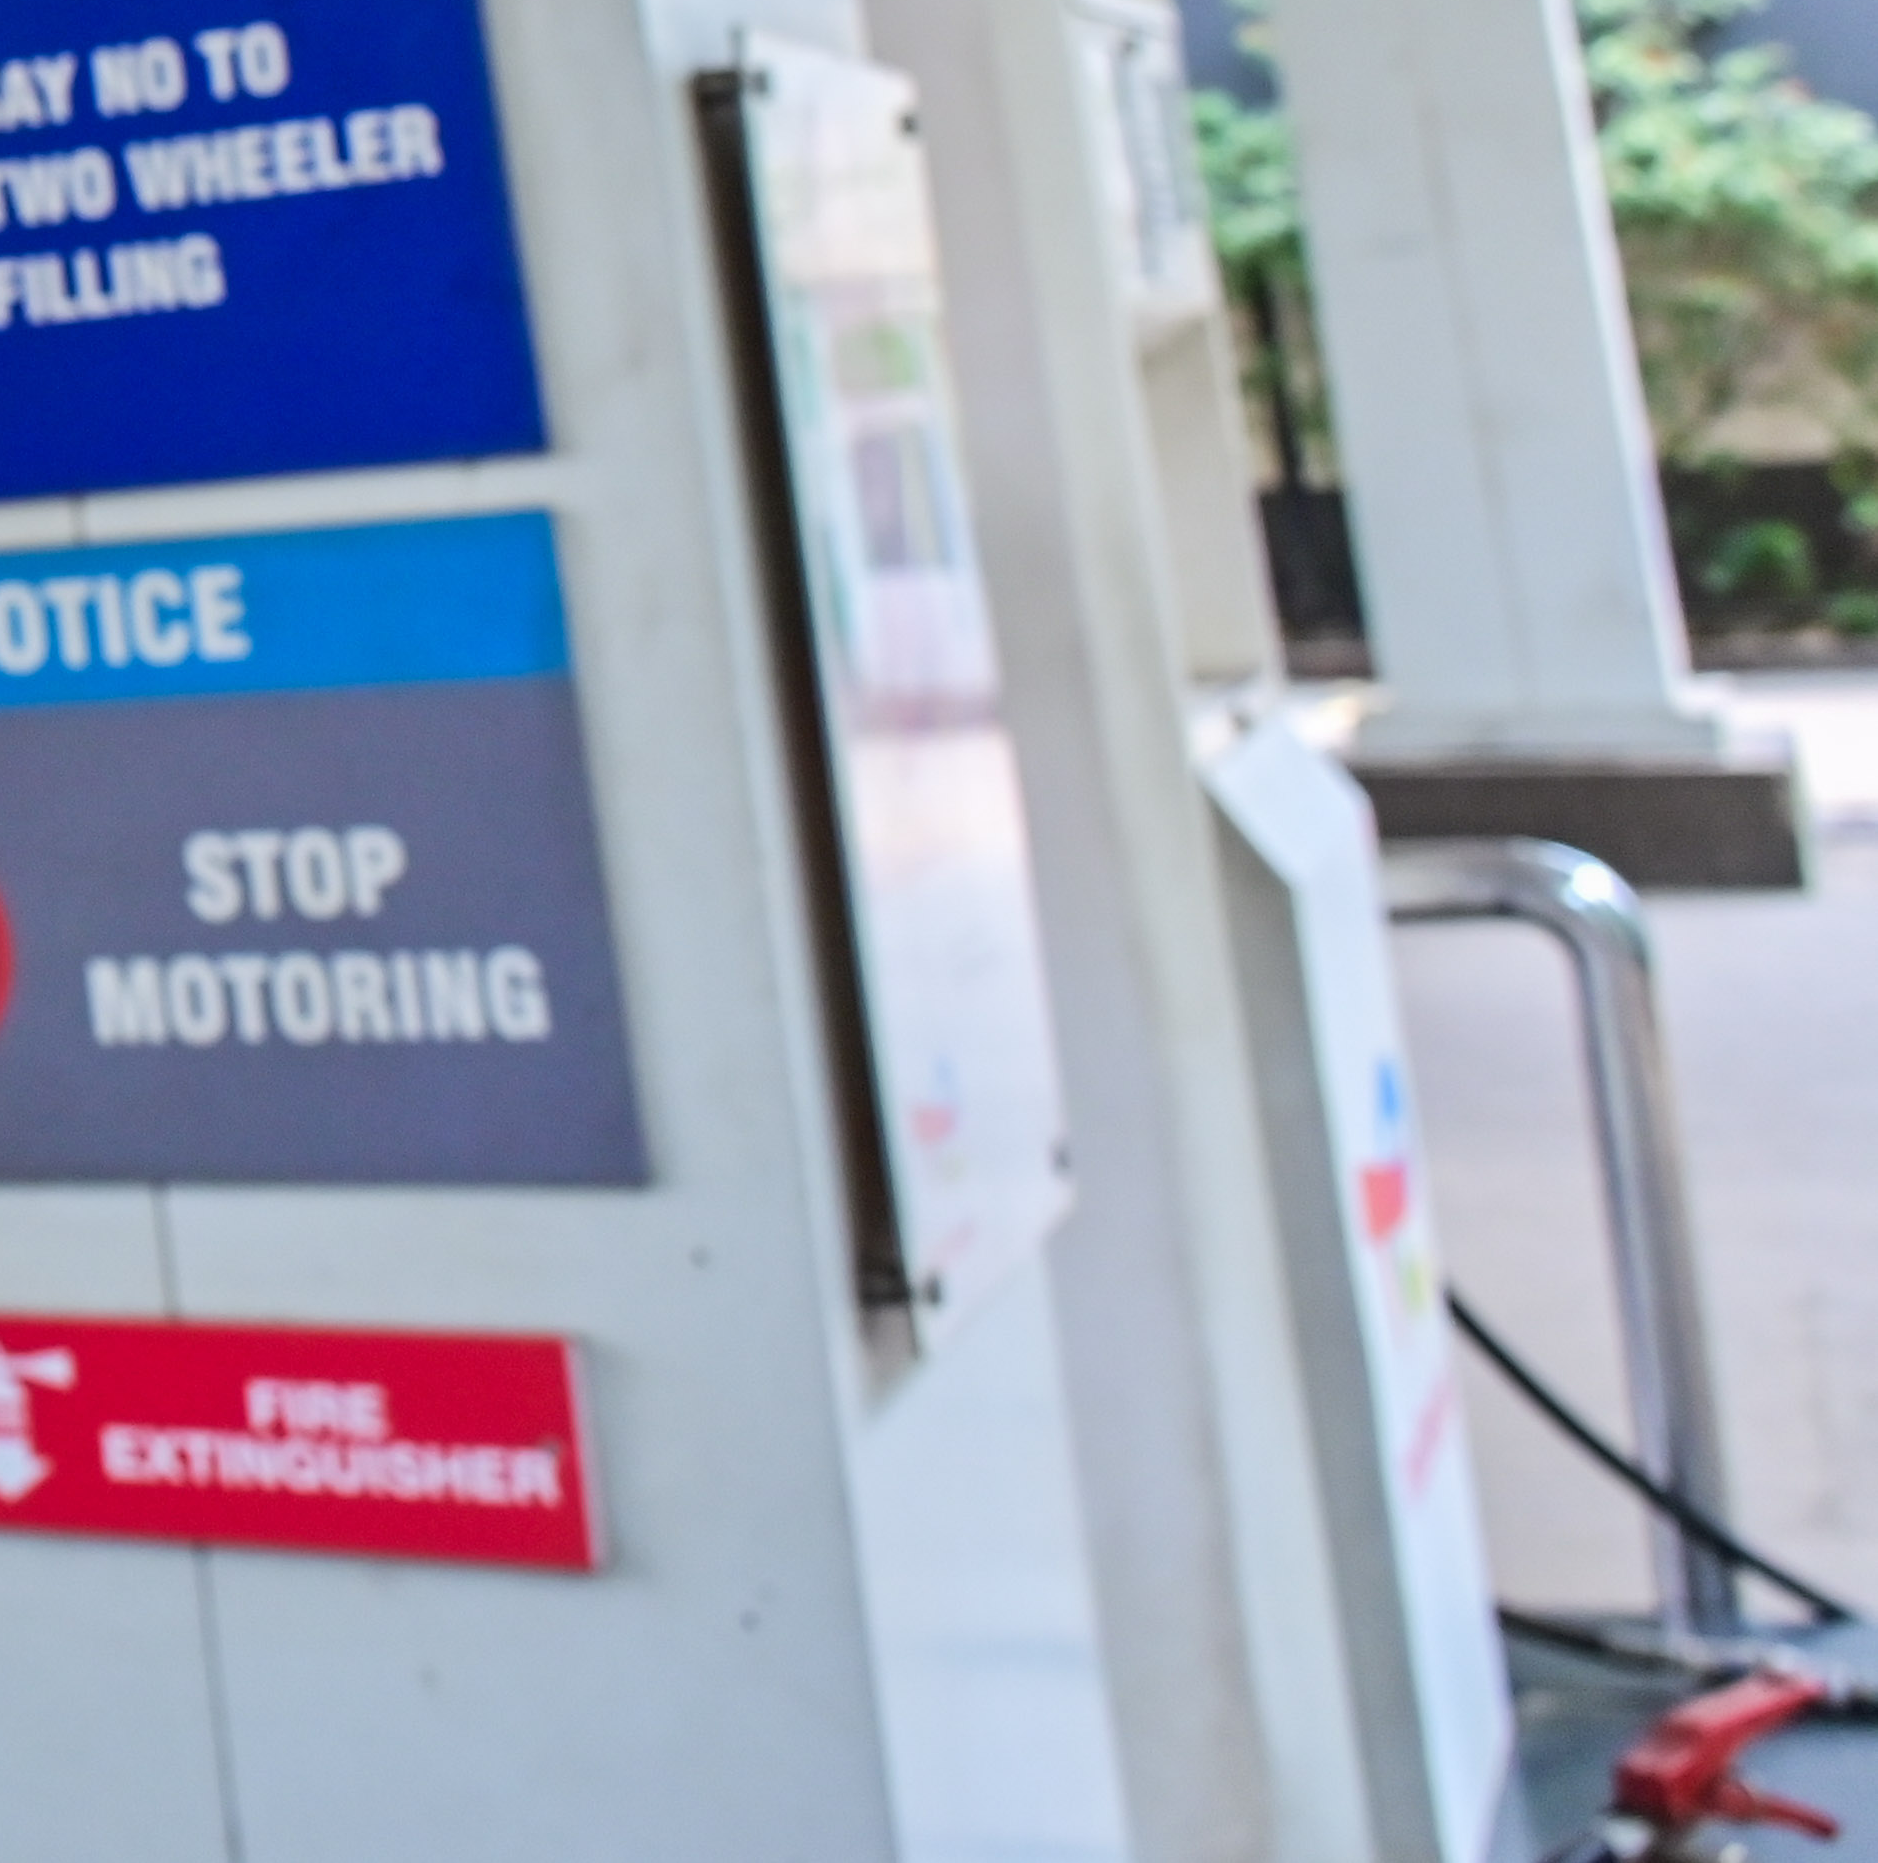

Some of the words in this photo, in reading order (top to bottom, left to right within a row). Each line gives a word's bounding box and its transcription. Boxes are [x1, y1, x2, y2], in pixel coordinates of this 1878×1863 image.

[90, 36, 187, 118] NO
[195, 21, 290, 103] TO
[123, 103, 444, 212] WHEELER
[181, 825, 407, 925] STOP
[85, 945, 552, 1048] MOTORING
[246, 1377, 390, 1438] FIRE
[99, 1423, 561, 1508] EXTINGUISHER
